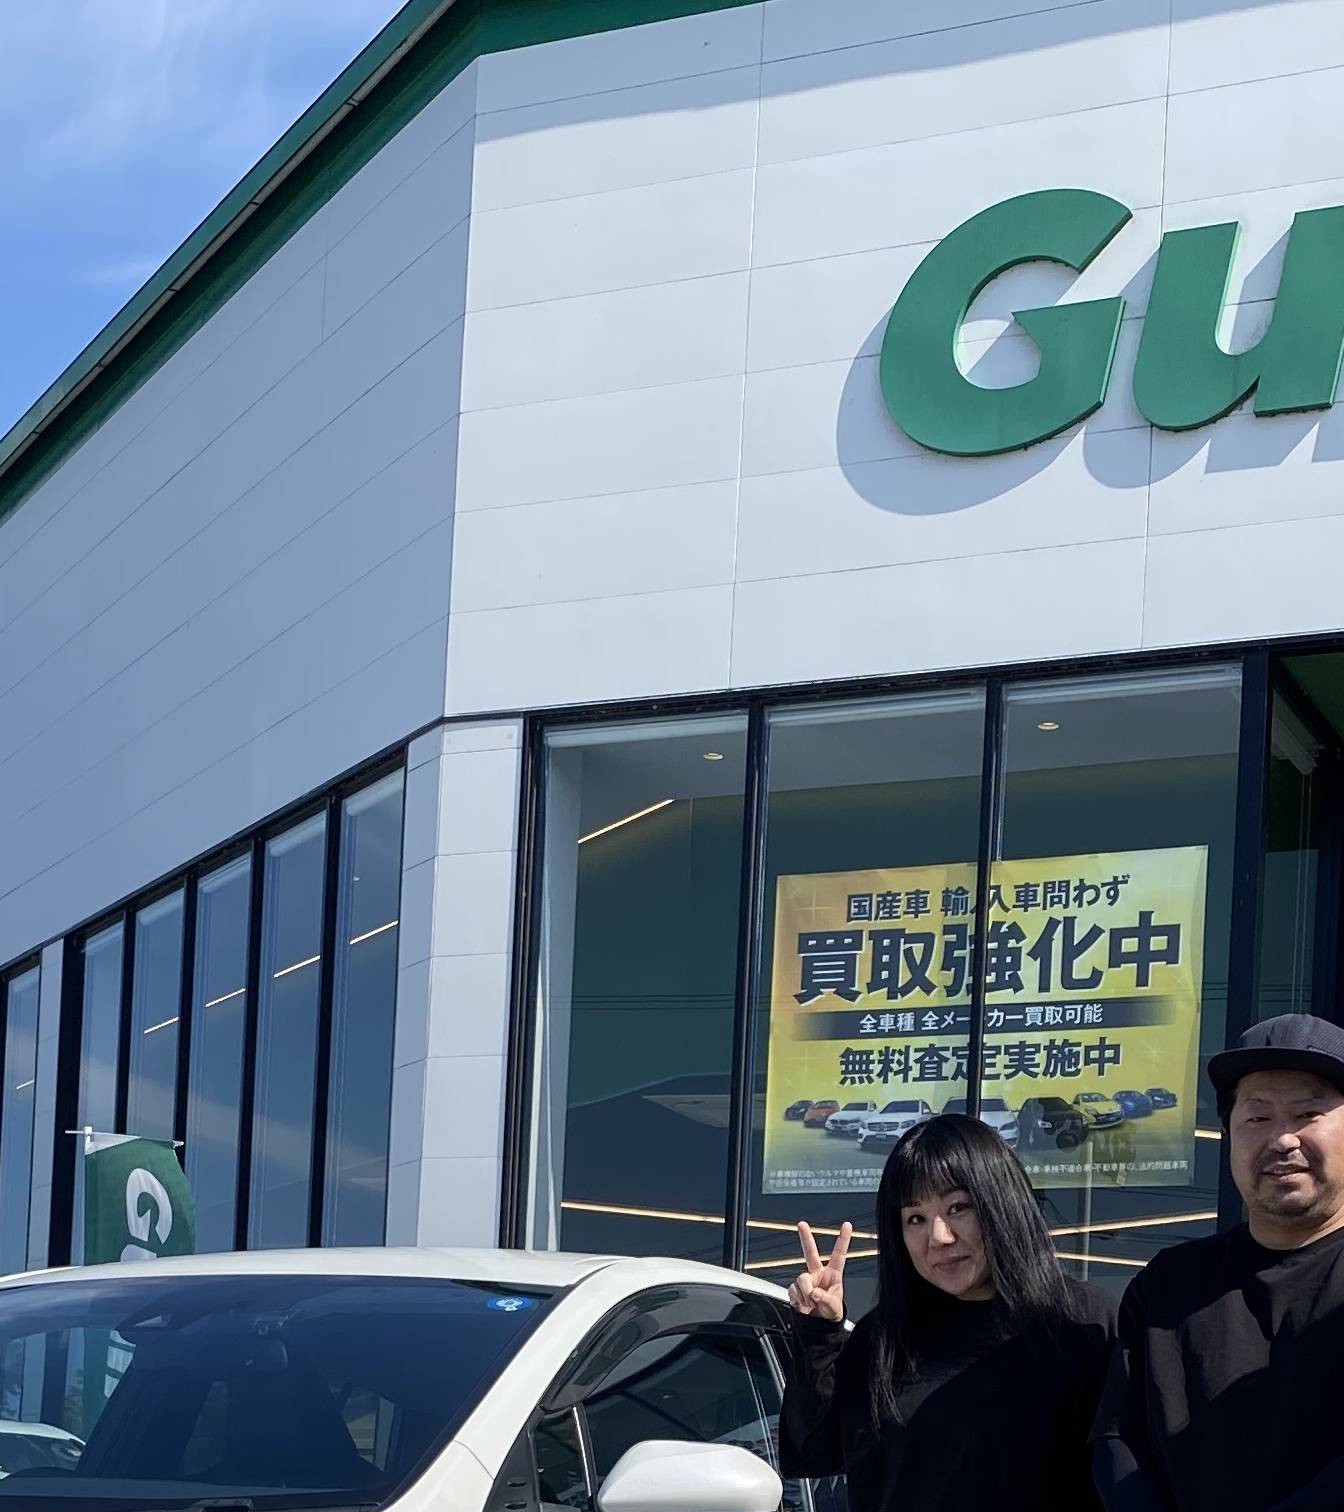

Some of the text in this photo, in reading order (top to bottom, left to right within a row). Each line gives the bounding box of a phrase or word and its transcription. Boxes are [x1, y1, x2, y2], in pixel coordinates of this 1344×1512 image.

[846, 873, 1132, 923] 国産車 輸入車問わず
[793, 909, 1183, 1008] 買取強化中
[859, 1010, 916, 1034] 全車種
[838, 1036, 1122, 1087] 無料査定実施中
